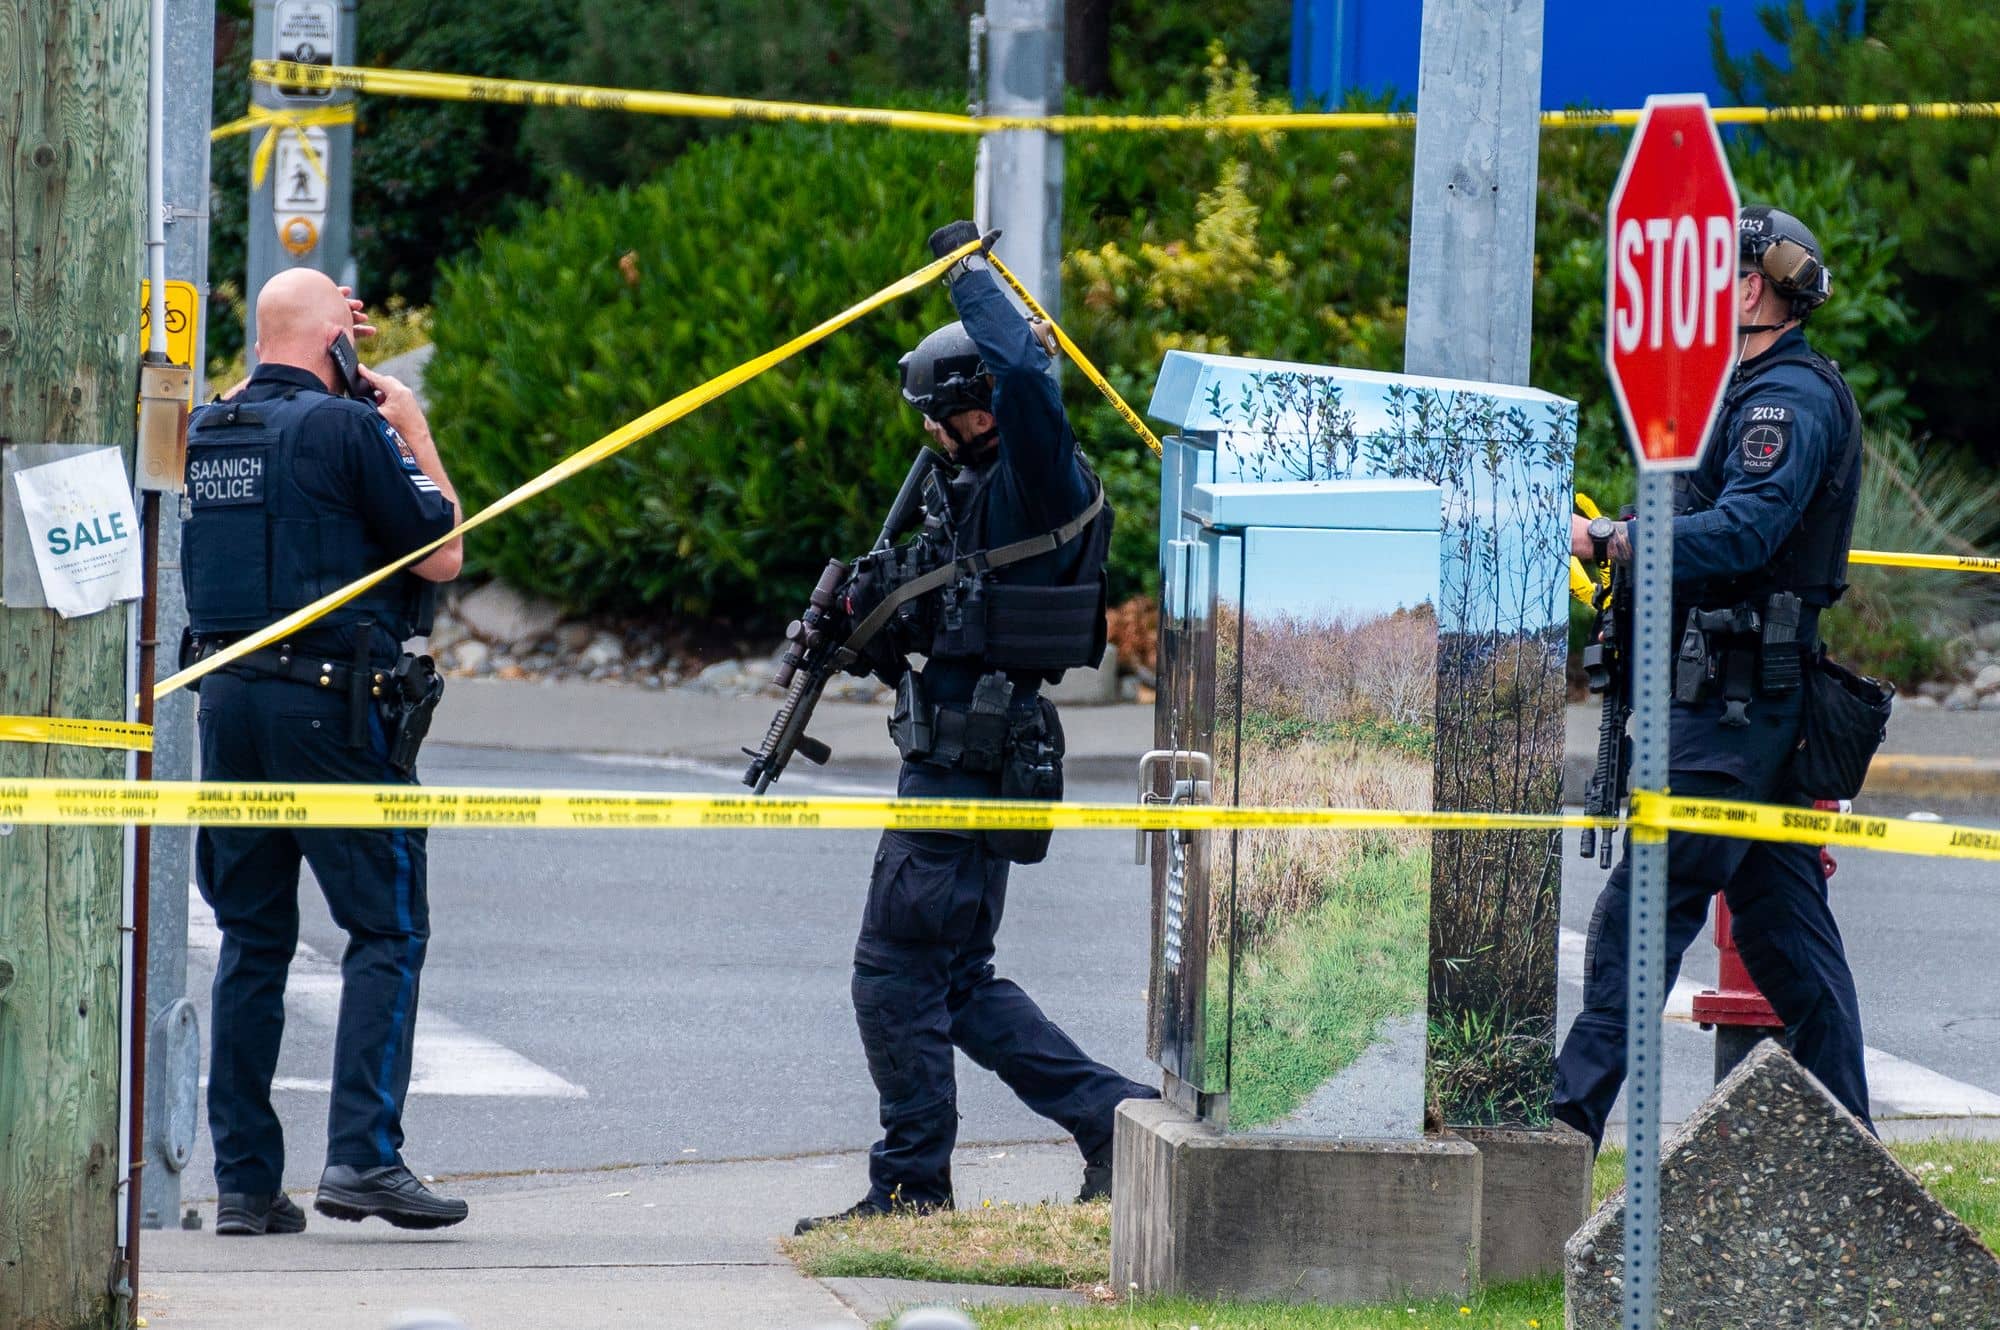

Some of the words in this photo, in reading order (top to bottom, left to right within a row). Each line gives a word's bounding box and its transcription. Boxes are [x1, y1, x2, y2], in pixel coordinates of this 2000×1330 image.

[1616, 214, 1733, 355] STOP
[1752, 406, 1785, 420] Z03
[190, 457, 262, 481] SAANICH
[195, 478, 254, 500] POLICE
[47, 511, 128, 556] SALE
[1781, 811, 1831, 833] CROSS
[1834, 818, 1862, 836] NOT
[1866, 822, 1887, 838] DO
